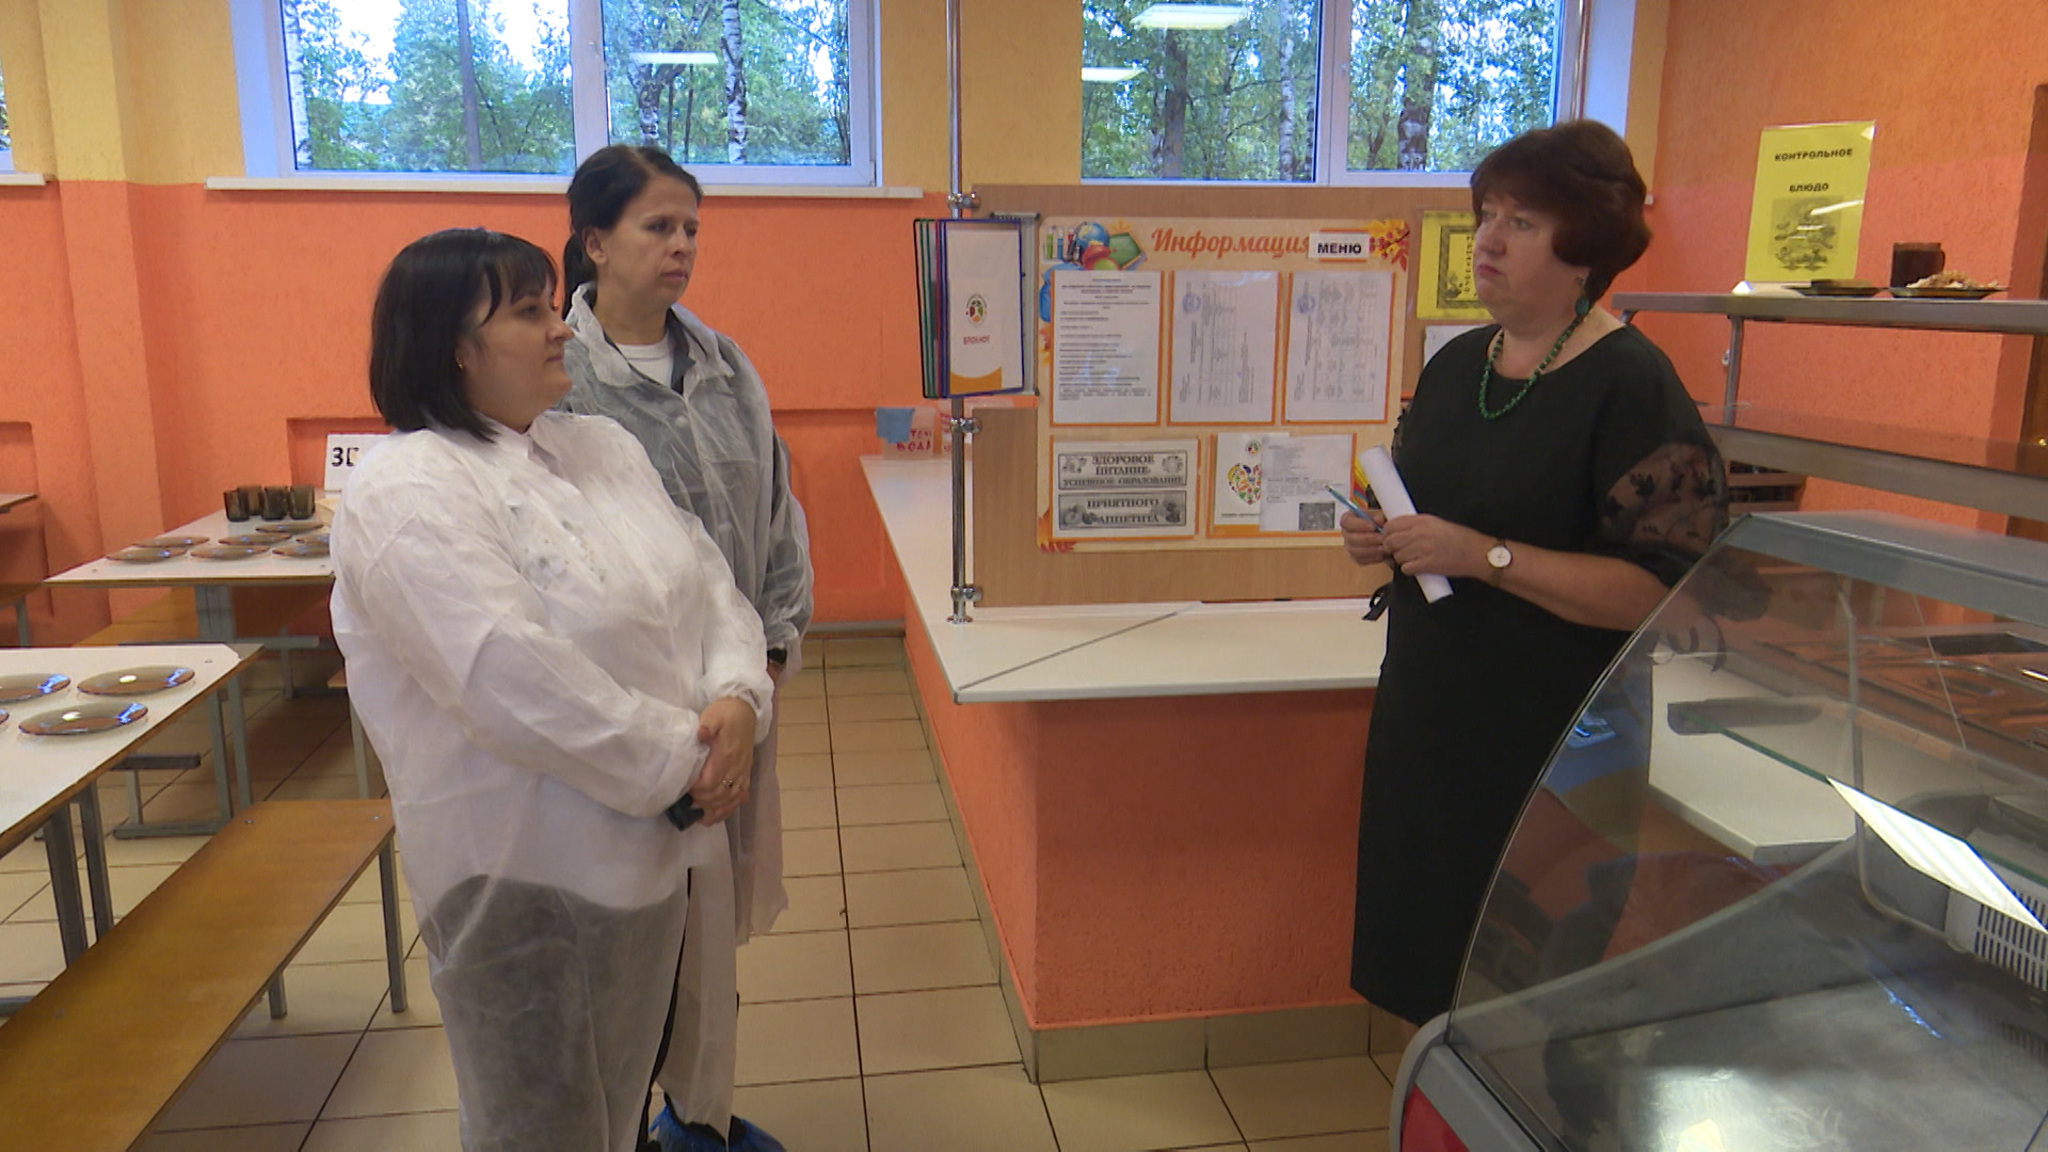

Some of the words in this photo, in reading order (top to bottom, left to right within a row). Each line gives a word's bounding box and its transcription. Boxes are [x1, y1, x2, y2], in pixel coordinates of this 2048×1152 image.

[1775, 148, 1853, 161] КОНТРОЛЬНОЕ
[1789, 182, 1830, 193] БЛЮДО
[1317, 243, 1362, 255] МЕНЮ
[1087, 498, 1159, 508] ПРИЯТНОГО
